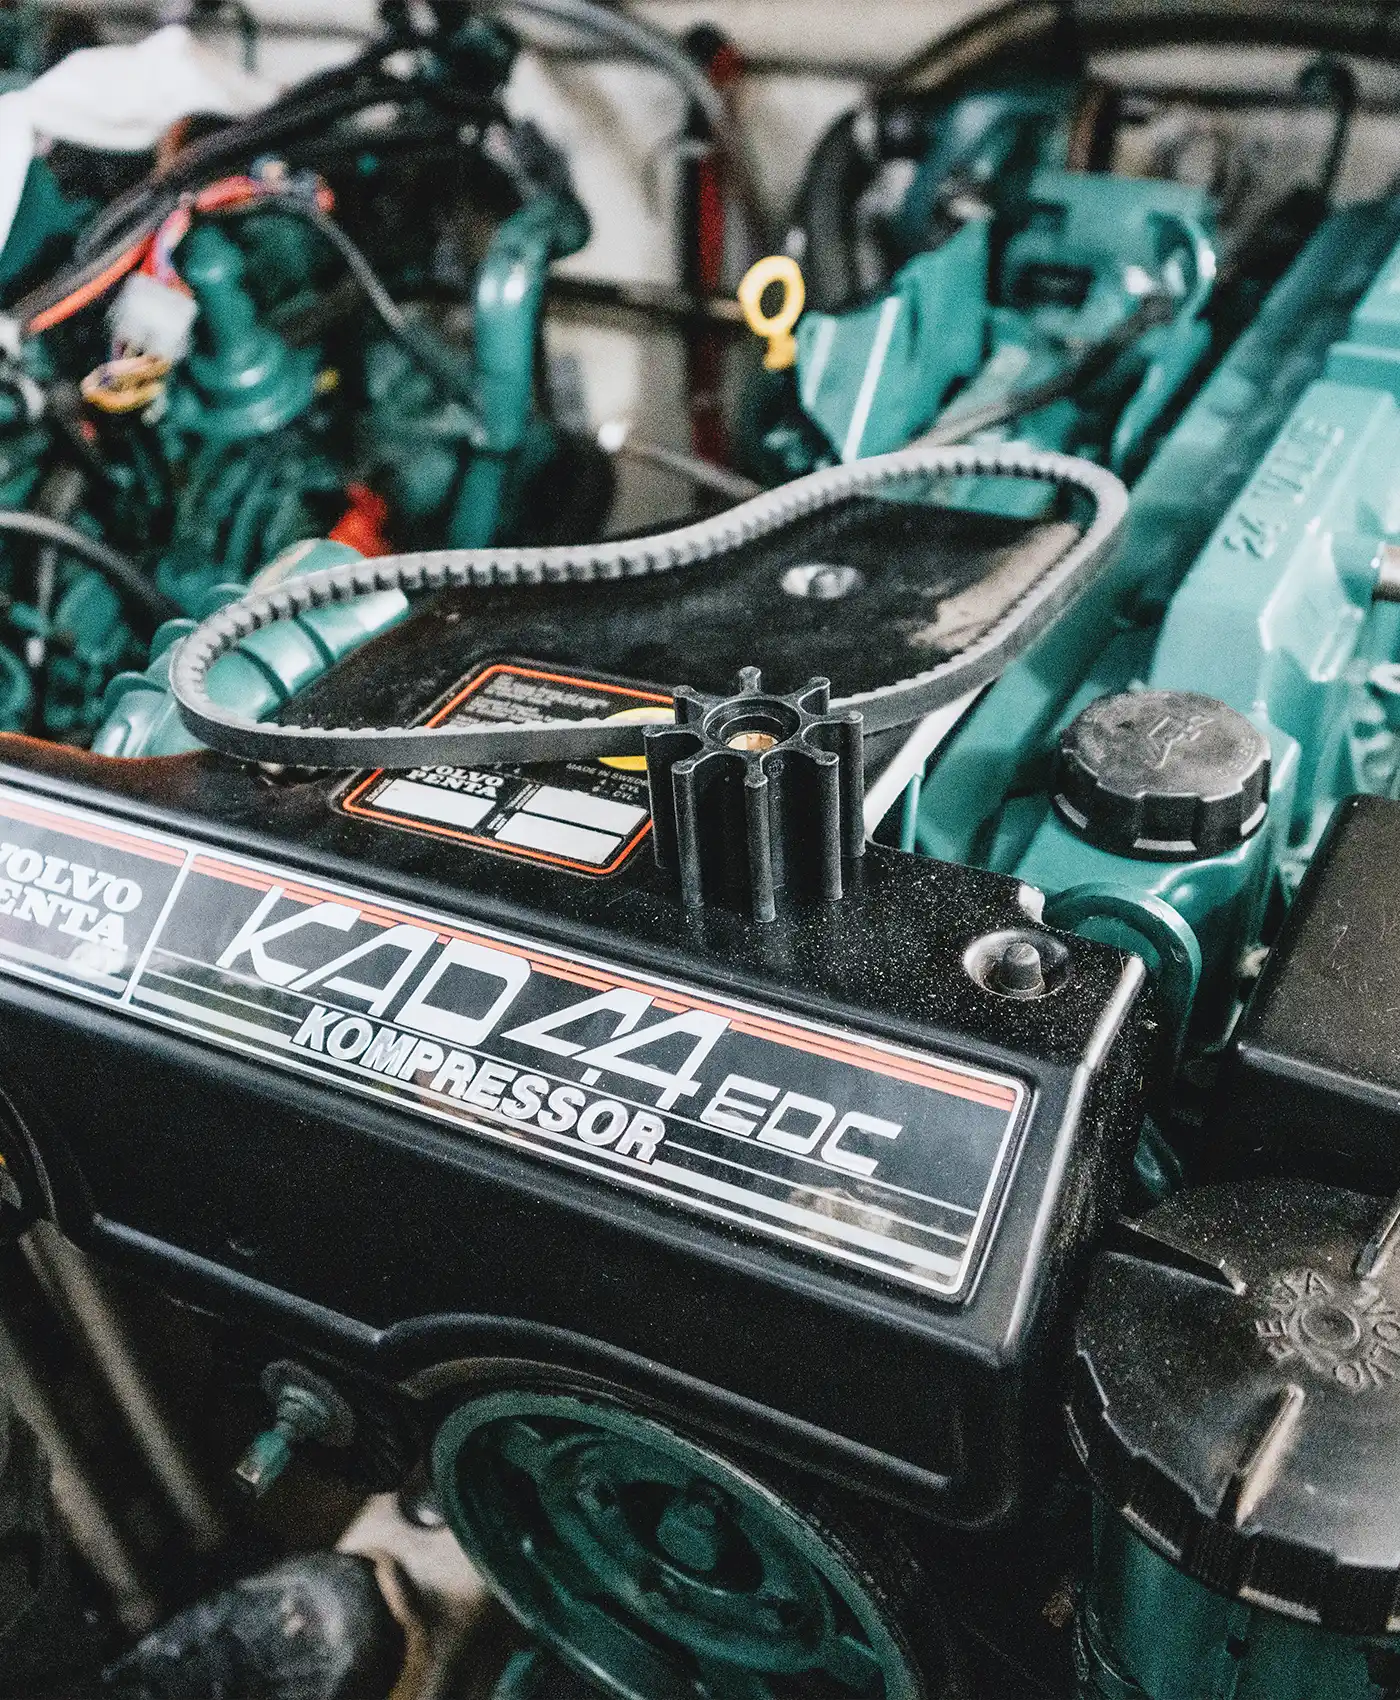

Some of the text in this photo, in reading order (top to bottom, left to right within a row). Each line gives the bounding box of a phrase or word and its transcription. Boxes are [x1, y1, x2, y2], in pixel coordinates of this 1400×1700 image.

[405, 769, 497, 799] PENTA
[566, 762, 597, 775] MADE
[611, 772, 650, 787] SWEDE
[0, 877, 129, 951] ENTA
[291, 1005, 666, 1163] KOMPRESSOR
[699, 1073, 902, 1176] EDC
